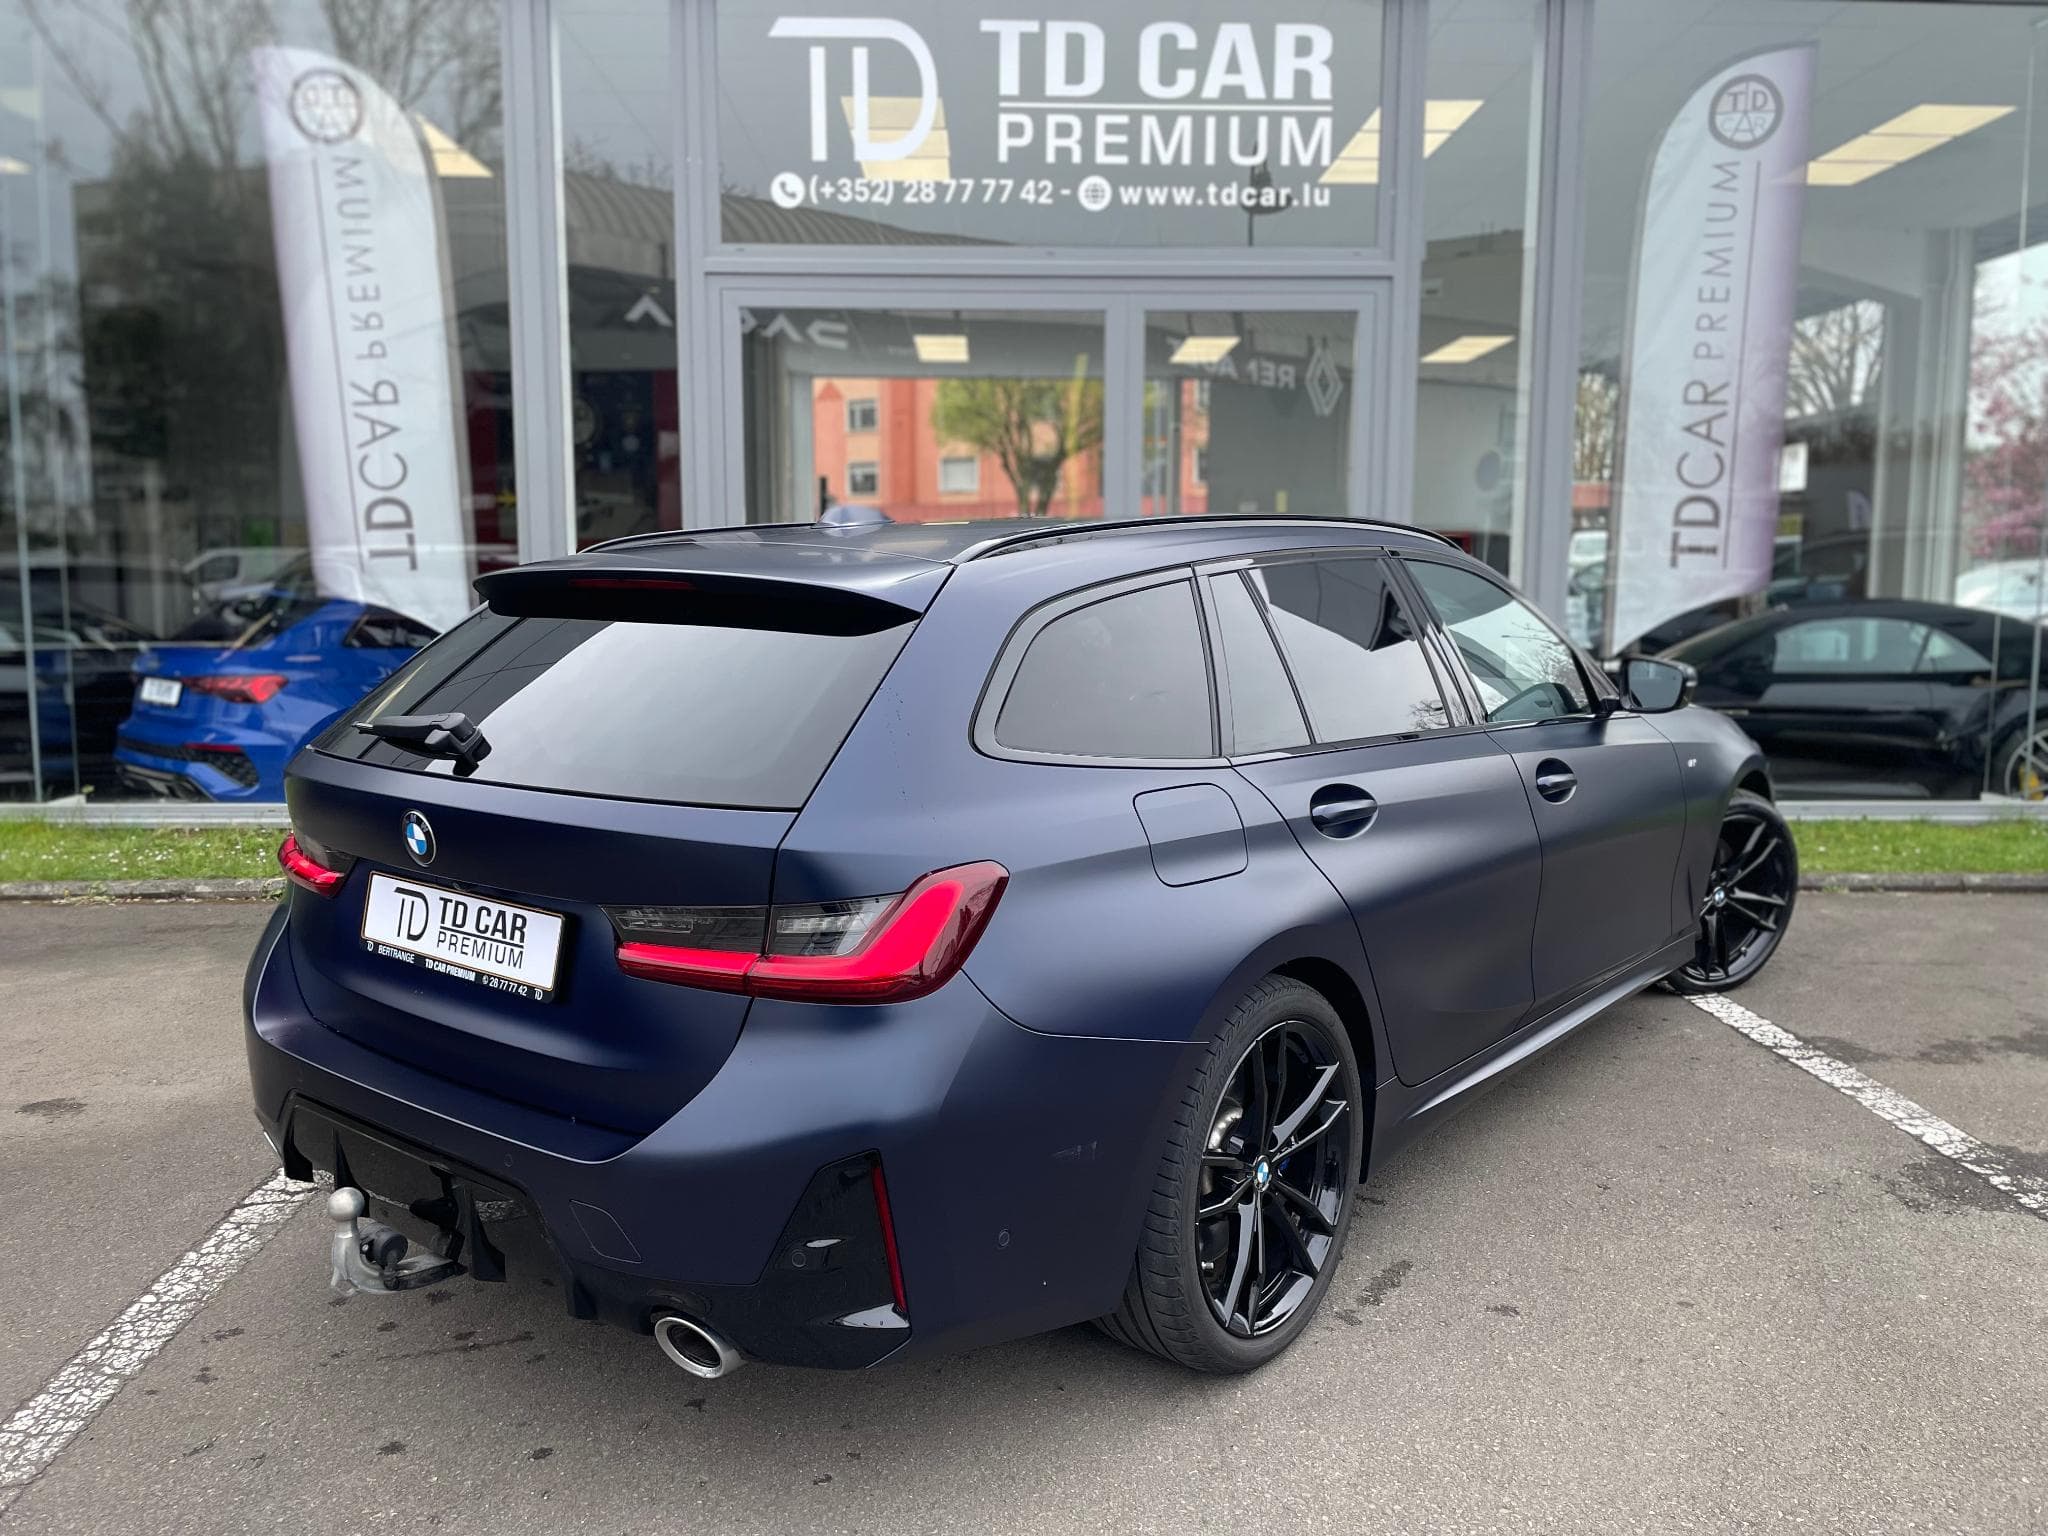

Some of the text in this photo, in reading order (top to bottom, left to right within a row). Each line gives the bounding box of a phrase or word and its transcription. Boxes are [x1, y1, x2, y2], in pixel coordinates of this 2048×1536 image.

[980, 19, 1334, 100] TD CAR
[998, 113, 1334, 167] PREMIUM
[808, 175, 894, 206] (+352)
[903, 178, 936, 204] 28
[941, 178, 975, 204] 77
[981, 179, 1014, 204] 77
[1019, 179, 1054, 205] 42
[1118, 181, 1331, 207] www.tdcar.lu
[1692, 160, 1741, 361] PREMIUM
[438, 896, 528, 944] TD CAR
[378, 944, 415, 964] BERTRANGE
[433, 960, 446, 973] CAR
[446, 964, 476, 982] PREMIUM
[489, 976, 499, 989] 28
[499, 979, 508, 991] 77
[509, 982, 518, 993] 77
[518, 985, 528, 997] 42
[436, 930, 524, 969] PREMIUM
